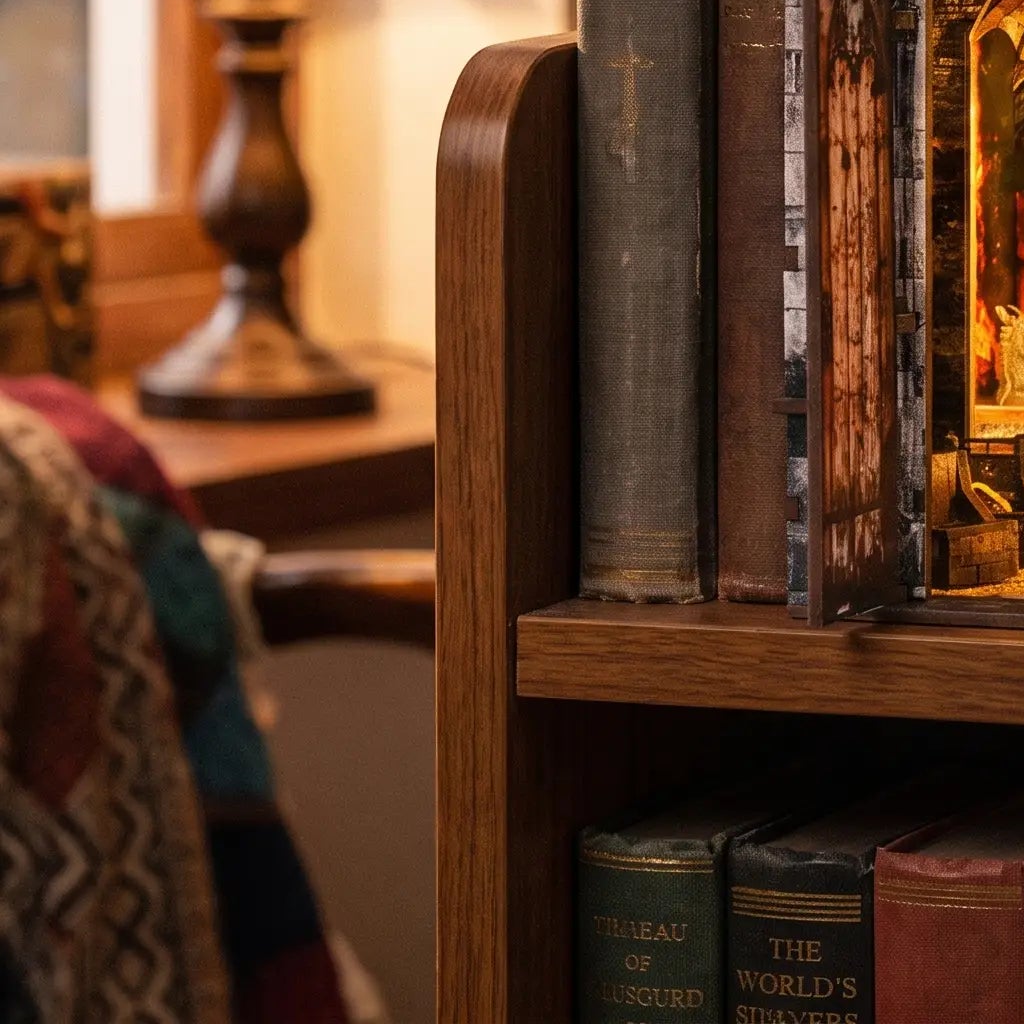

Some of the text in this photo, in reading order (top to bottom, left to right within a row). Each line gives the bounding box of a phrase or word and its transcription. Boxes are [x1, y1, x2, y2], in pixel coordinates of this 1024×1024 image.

[768, 937, 823, 962] THE
[624, 954, 652, 972] OF
[736, 969, 858, 999] WORLD'S
